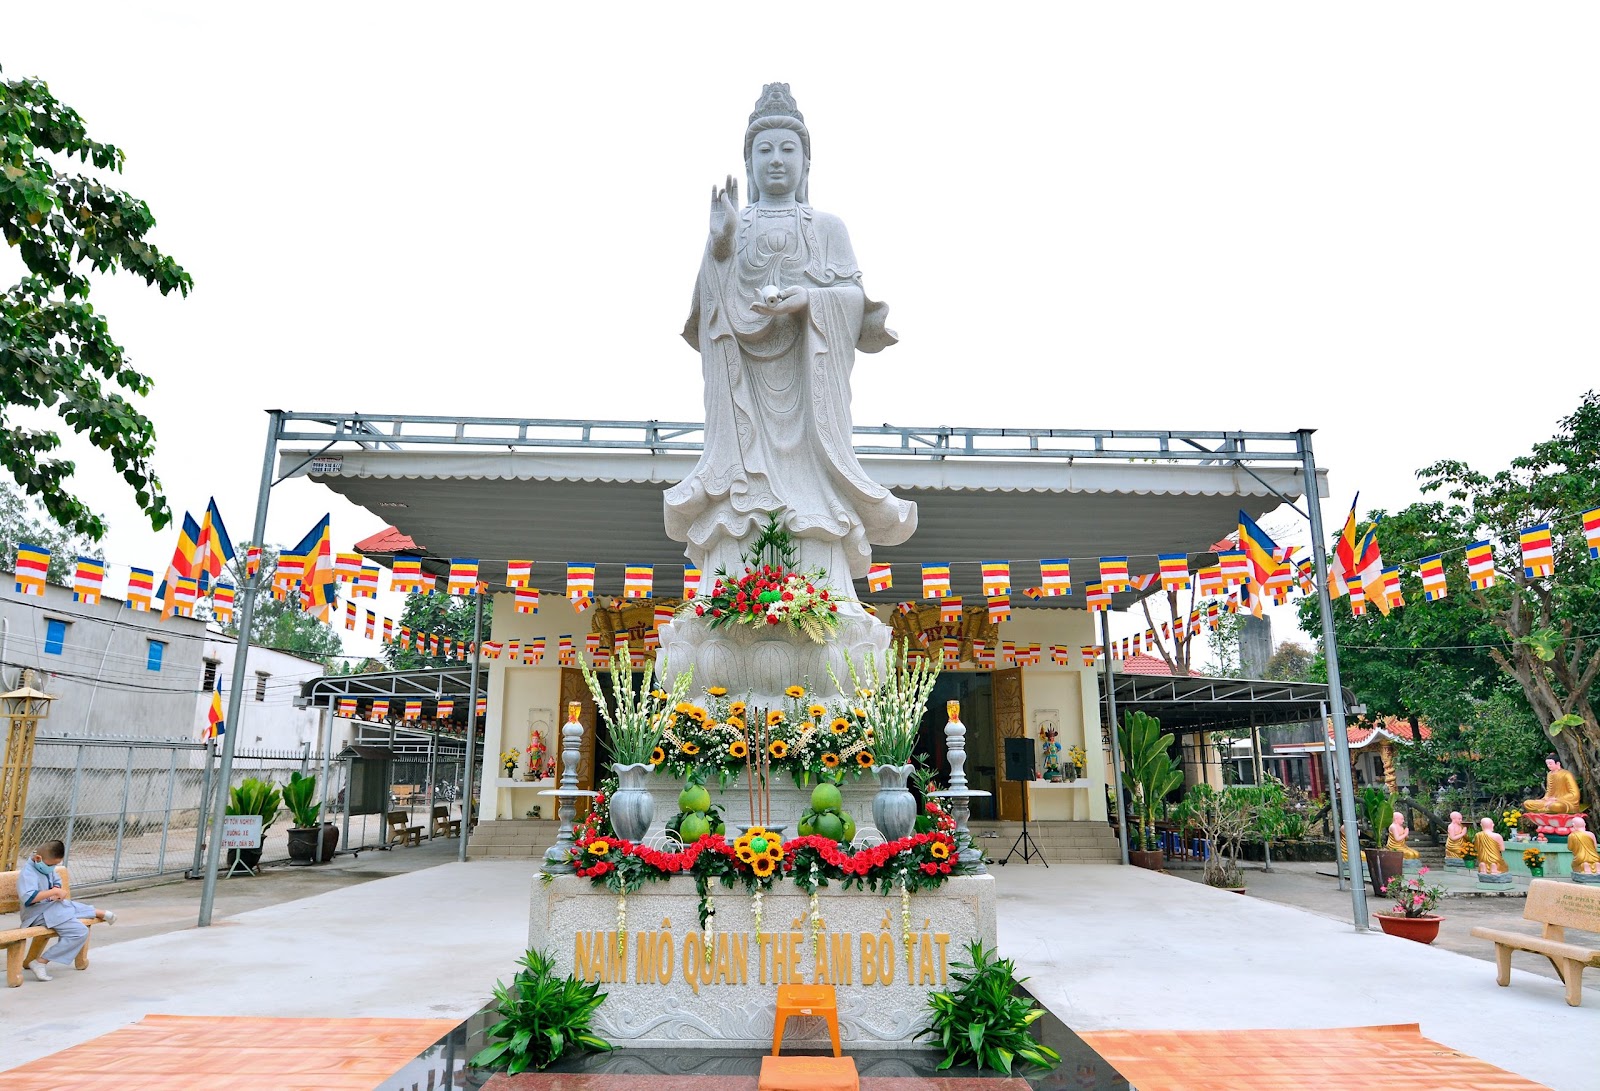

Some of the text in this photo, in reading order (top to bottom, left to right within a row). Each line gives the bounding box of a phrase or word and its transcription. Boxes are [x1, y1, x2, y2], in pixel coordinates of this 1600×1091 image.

[575, 908, 951, 996] NAM MÔ QUAN THẾ ÂM BỒ TÁT
